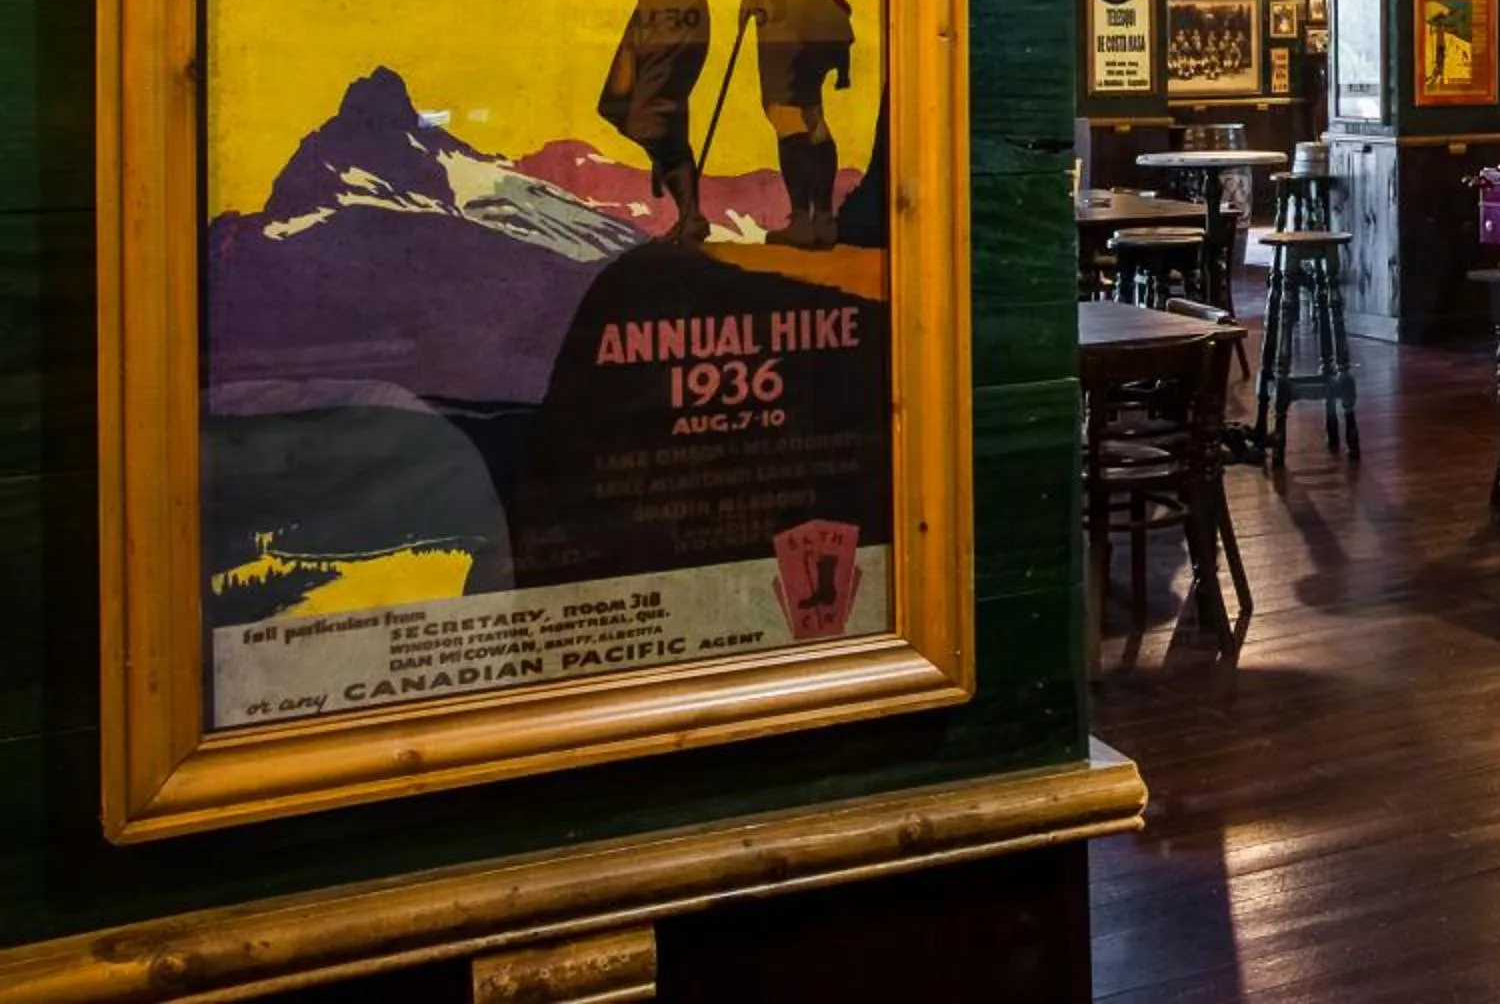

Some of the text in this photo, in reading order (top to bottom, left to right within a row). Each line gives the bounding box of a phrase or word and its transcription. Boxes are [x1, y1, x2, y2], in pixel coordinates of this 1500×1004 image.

[596, 307, 860, 365] ANNUAL HIKE
[670, 358, 785, 409] 1936
[284, 615, 380, 645] particulars
[384, 609, 426, 627] from
[390, 591, 662, 641] SECRETARY, ROOM 318
[390, 635, 464, 656] WINDSOR
[390, 656, 432, 673] DAN
[246, 630, 766, 717] or any CANADIAN PACIFIC AGENT
